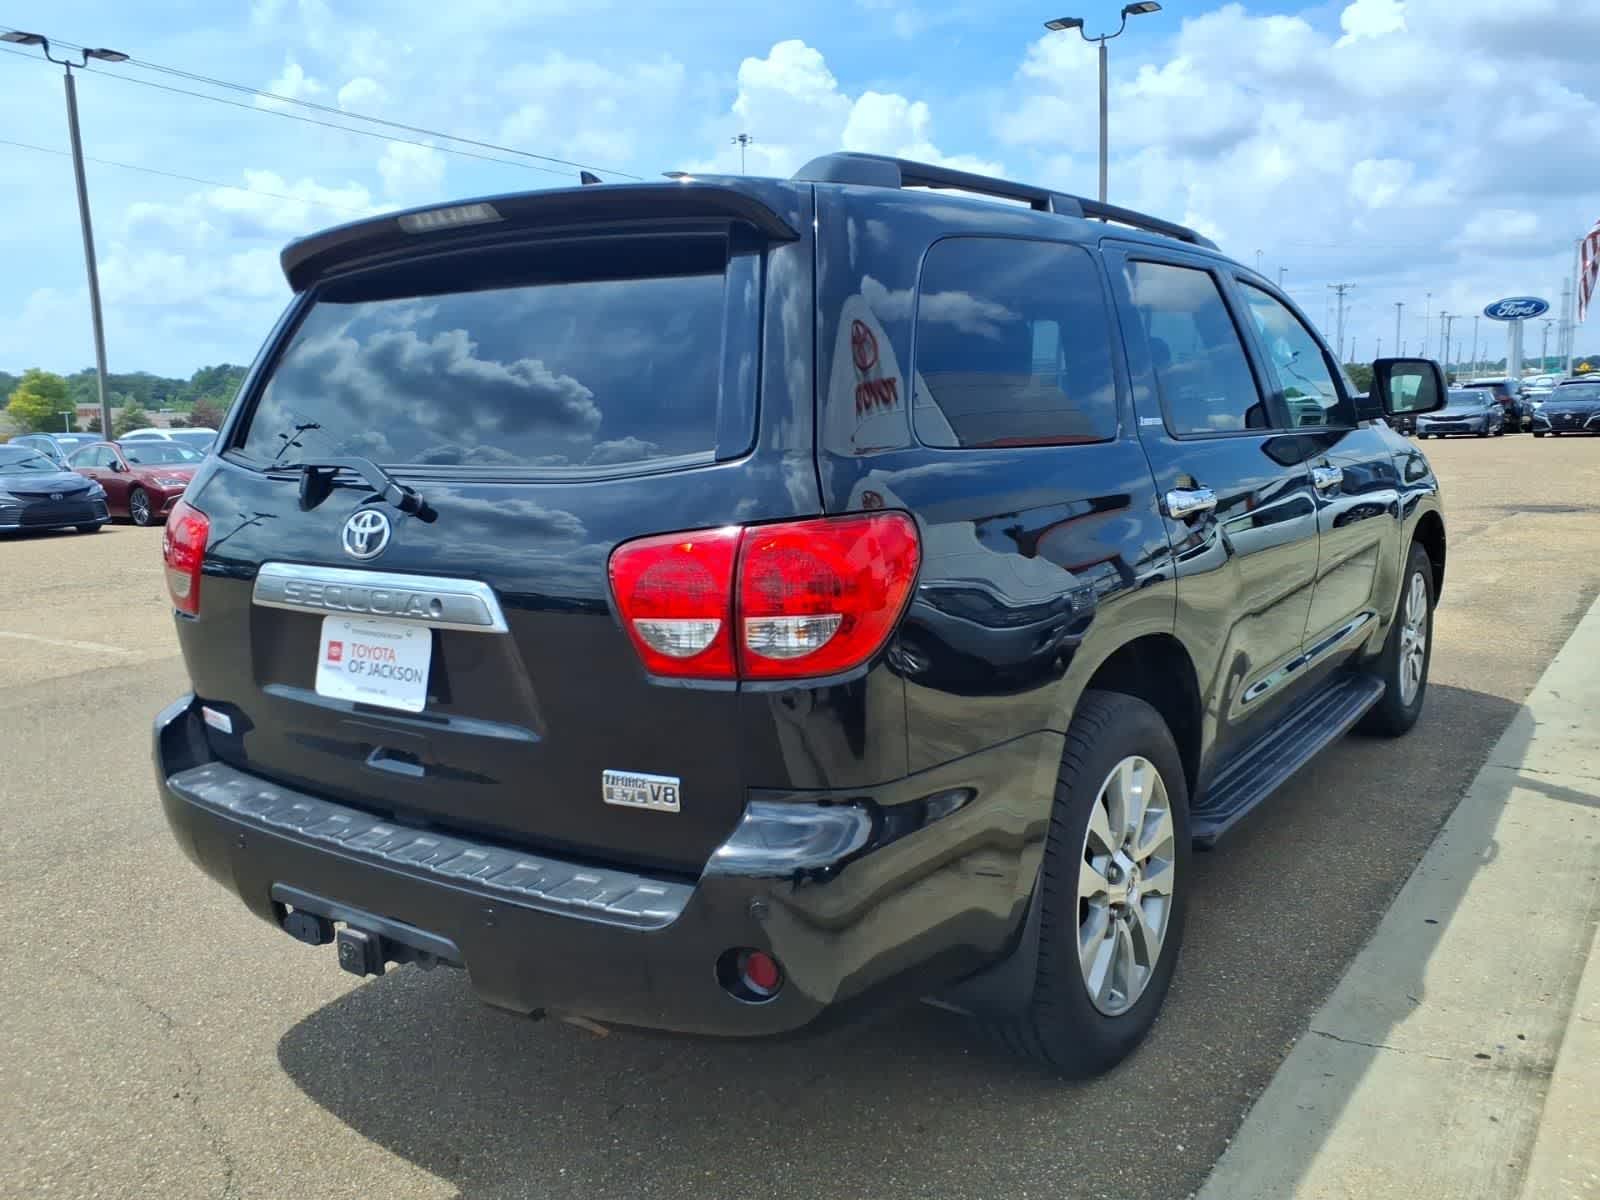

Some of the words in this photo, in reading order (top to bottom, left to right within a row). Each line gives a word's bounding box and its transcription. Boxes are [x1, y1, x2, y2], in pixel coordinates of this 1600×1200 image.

[1497, 301, 1536, 316] Ford
[284, 581, 430, 617] SEQUOIA
[350, 643, 396, 662] TOYOTA
[348, 659, 366, 673] OF
[367, 662, 423, 684] JACKSON
[650, 784, 676, 804] V8
